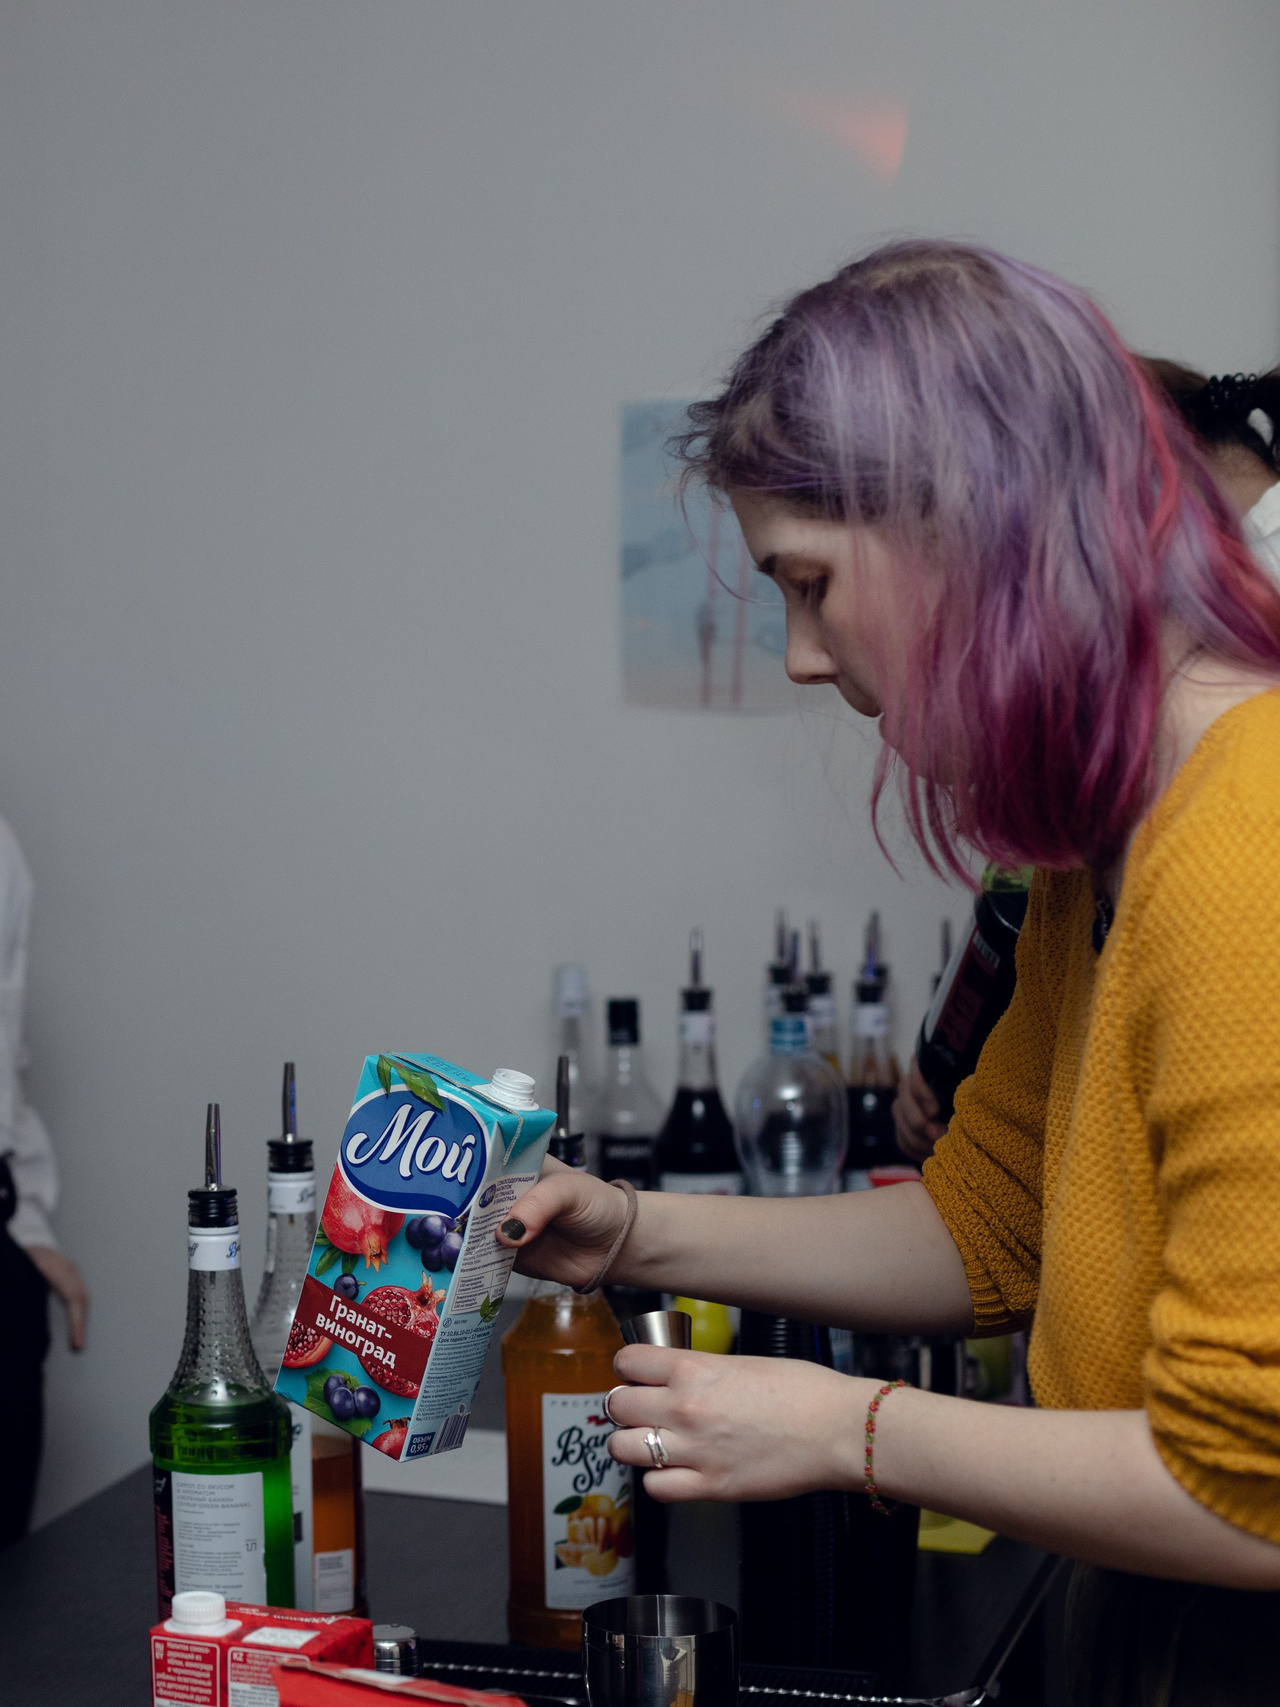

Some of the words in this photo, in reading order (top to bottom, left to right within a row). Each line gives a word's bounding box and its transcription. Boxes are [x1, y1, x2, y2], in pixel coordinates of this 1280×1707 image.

[346, 1103, 476, 1184] Мой
[315, 1313, 396, 1369] виноград
[329, 1295, 392, 1339] Гранат-
